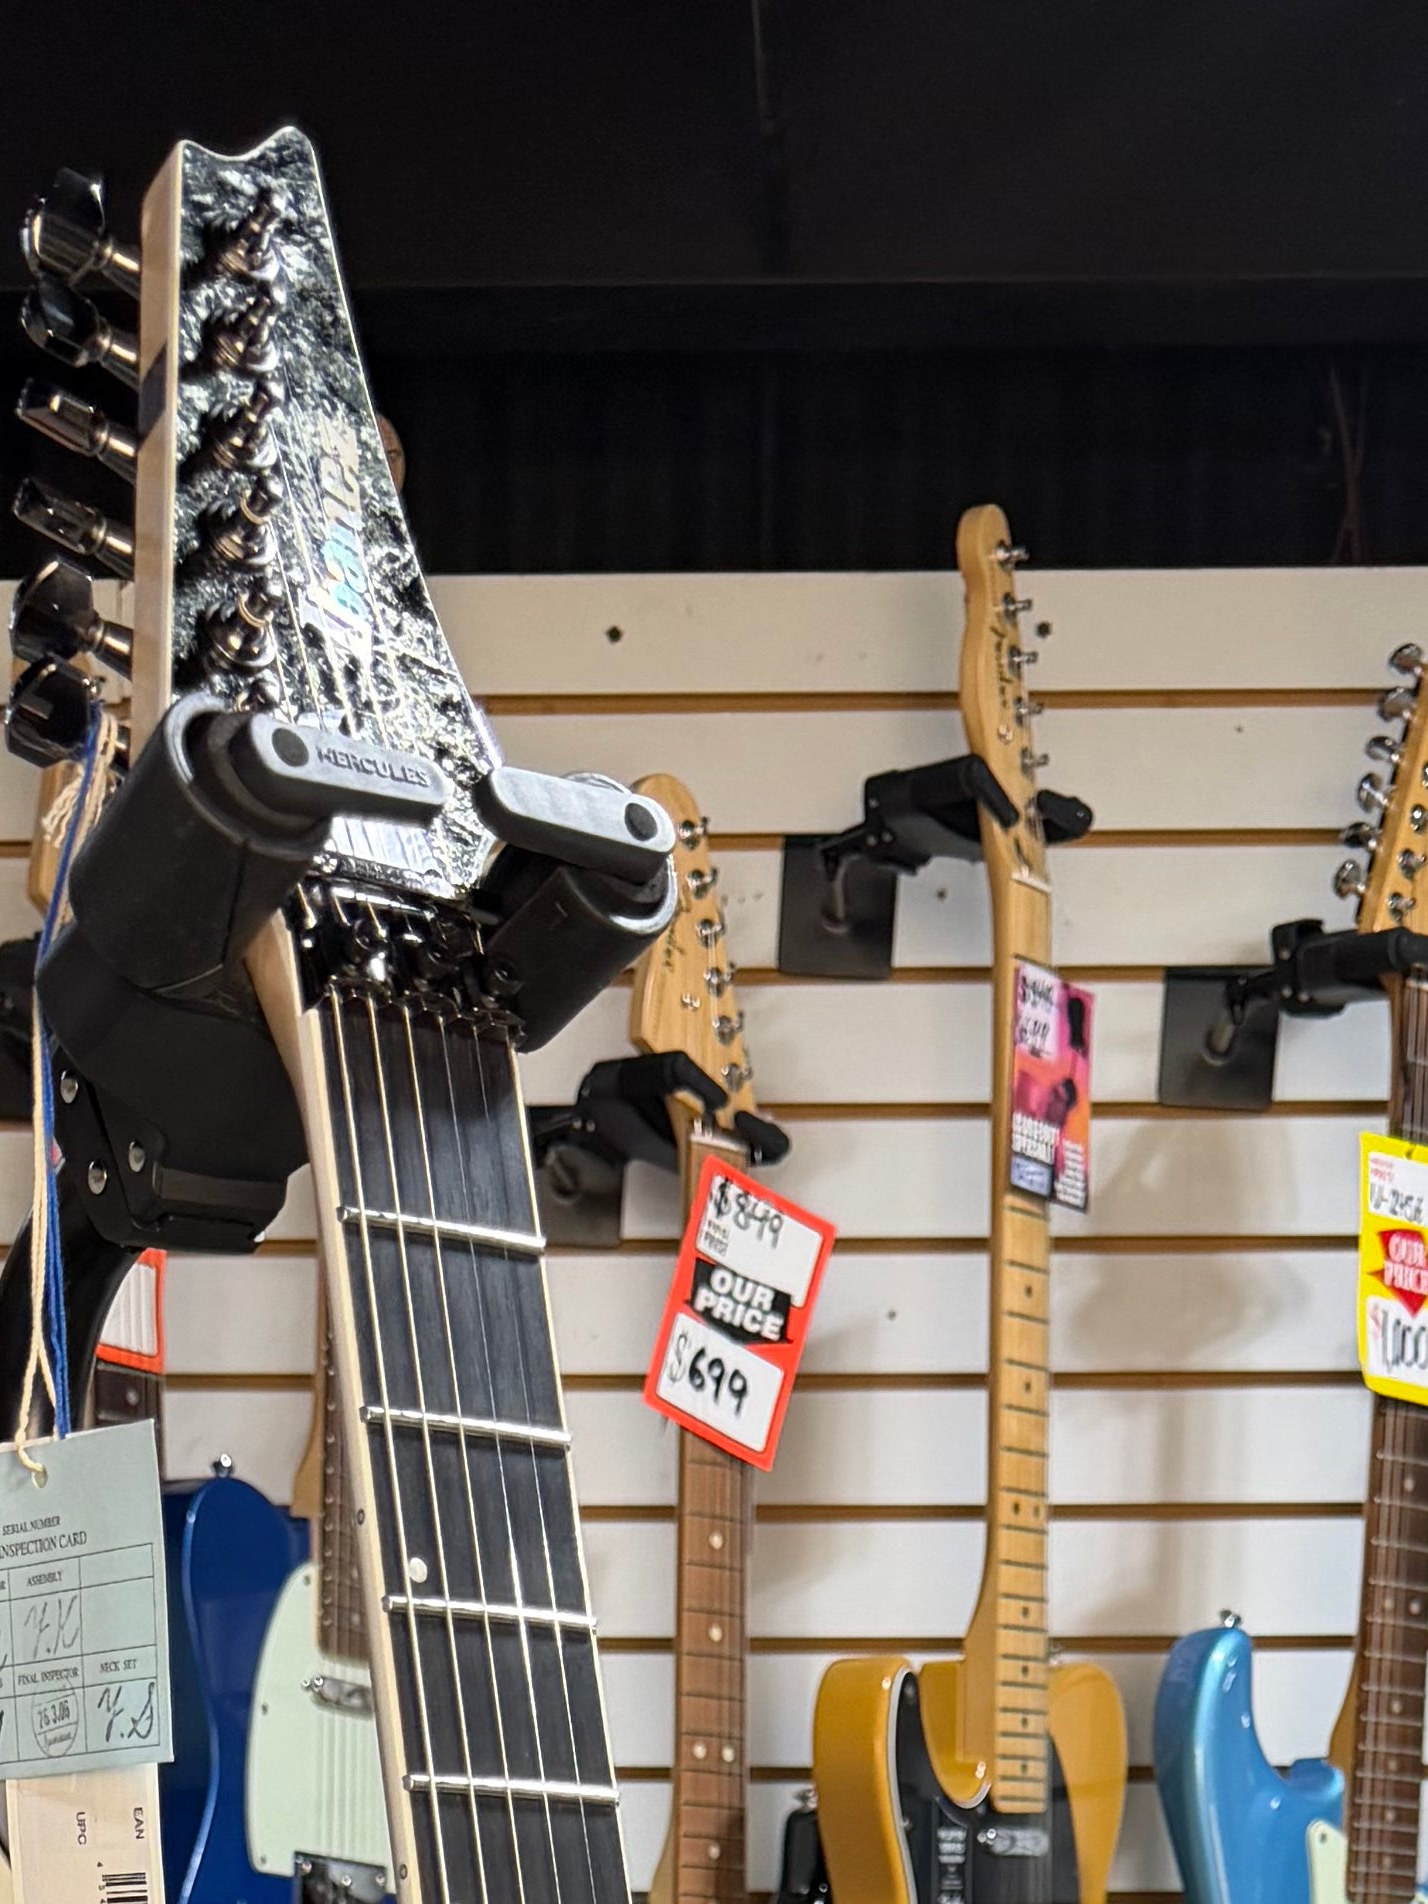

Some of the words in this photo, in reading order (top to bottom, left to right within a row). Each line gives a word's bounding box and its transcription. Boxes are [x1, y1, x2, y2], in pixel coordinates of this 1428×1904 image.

[315, 745, 431, 788] HERCULES
[709, 1266, 776, 1311] OUR
[693, 1290, 785, 1342] PRICE
[665, 1332, 749, 1420] $699
[2, 1520, 30, 1536] SERIAL
[30, 1515, 61, 1532] NUMBER
[58, 1530, 88, 1550] CARD
[26, 1570, 63, 1587] ASSEMBLY
[18, 1672, 39, 1686] FINAL
[39, 1667, 79, 1682] INSPECTOR
[99, 1661, 121, 1674] NECK
[122, 1658, 138, 1671] SET
[75, 1811, 87, 1846] UPC
[133, 1806, 145, 1840] EAN
